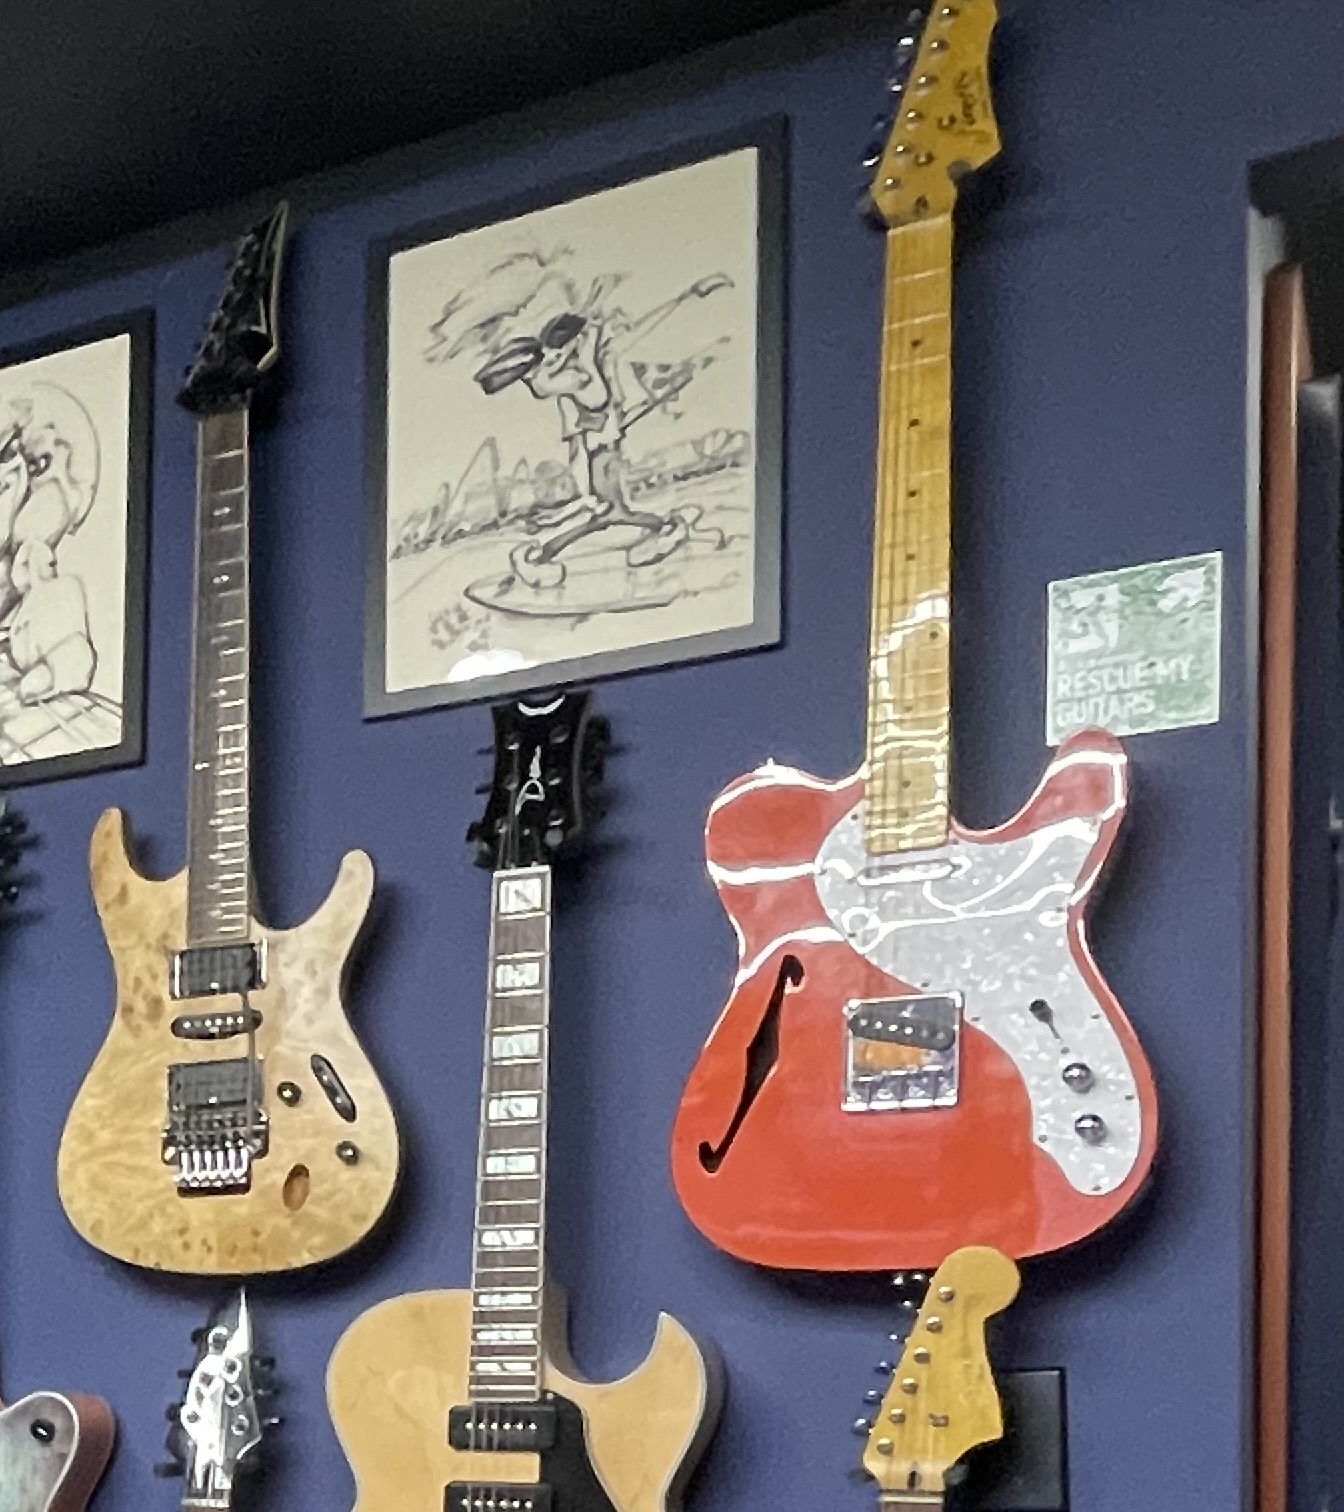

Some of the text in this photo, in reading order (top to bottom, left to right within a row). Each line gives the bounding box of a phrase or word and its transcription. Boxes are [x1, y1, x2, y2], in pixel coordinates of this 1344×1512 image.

[1056, 662, 1151, 698] RESCUE
[1156, 656, 1195, 684] MY
[1055, 690, 1156, 728] GUITARS
